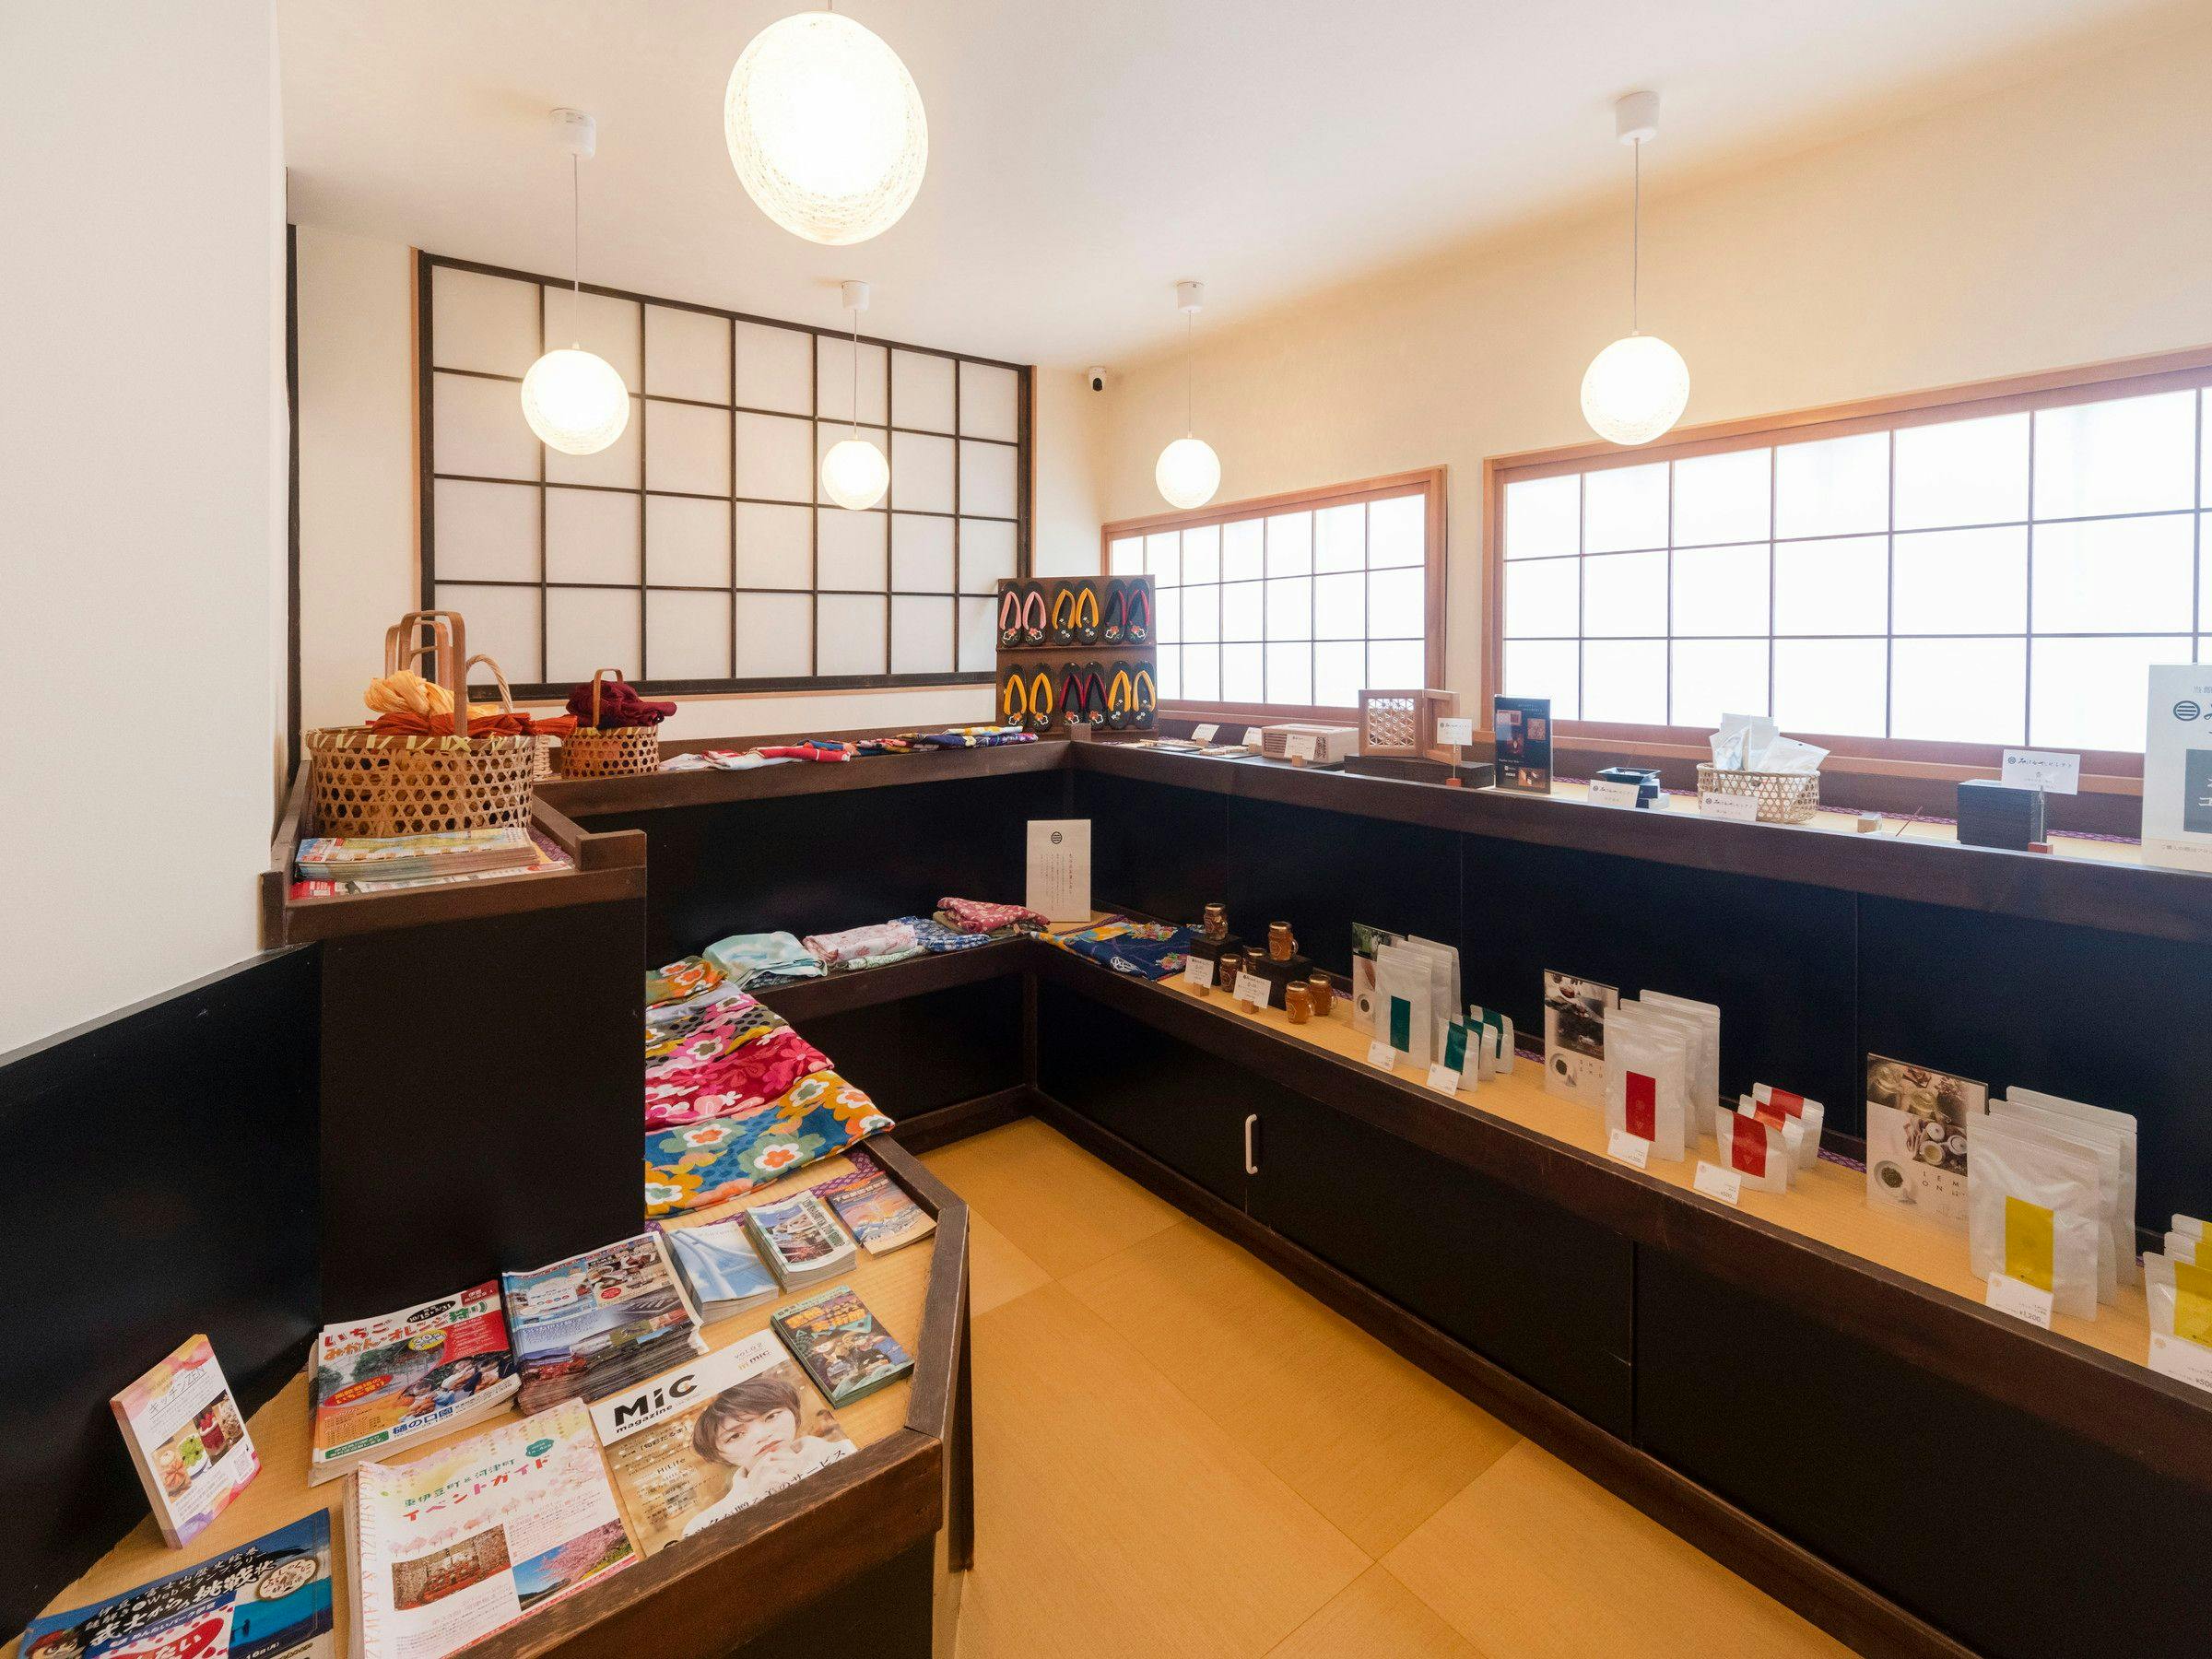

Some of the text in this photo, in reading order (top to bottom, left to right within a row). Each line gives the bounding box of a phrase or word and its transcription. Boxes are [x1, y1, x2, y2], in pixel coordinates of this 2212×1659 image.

[324, 1319, 393, 1347] いちご
[616, 1404, 673, 1434] magazine
[403, 1455, 550, 1522] イベントガイド
